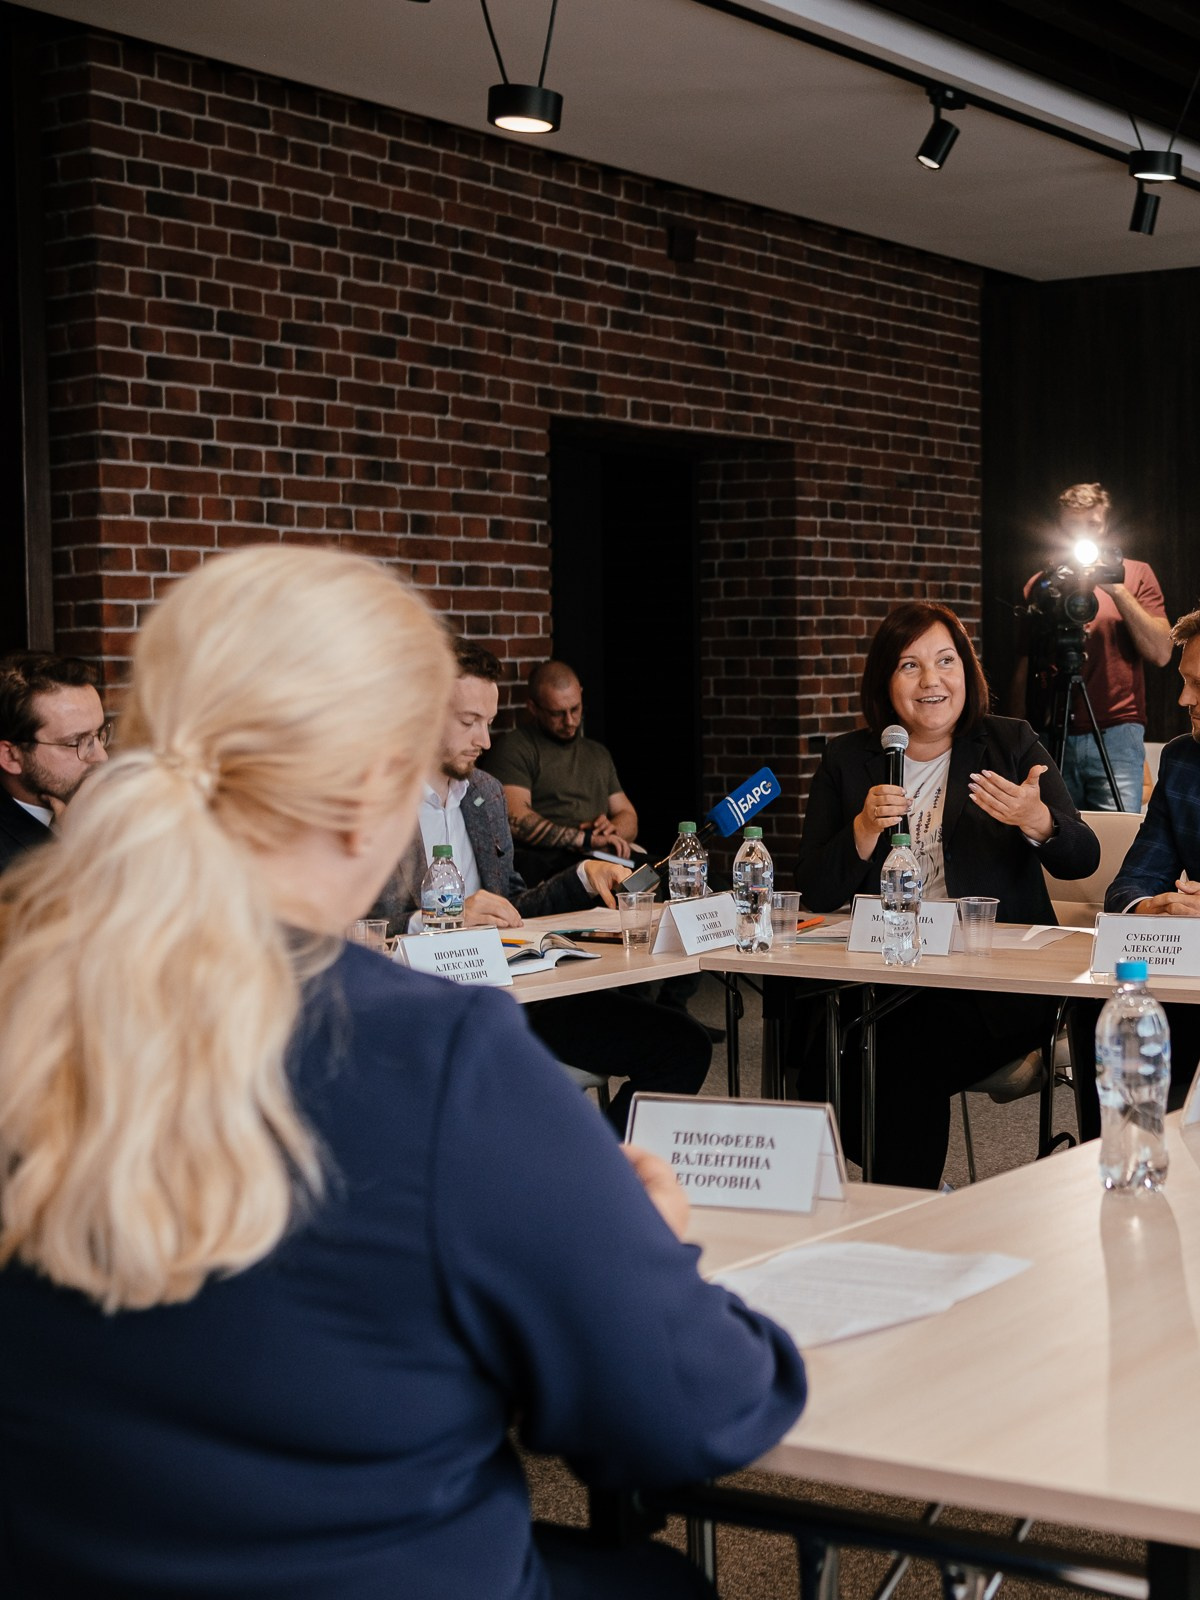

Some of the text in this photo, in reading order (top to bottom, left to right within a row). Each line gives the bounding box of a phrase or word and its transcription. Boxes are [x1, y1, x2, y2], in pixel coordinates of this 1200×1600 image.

[738, 780, 772, 814] БАРС
[695, 910, 719, 921] КОТЛЕР
[696, 929, 735, 944] ДМИТРИЕВИЧ
[1126, 933, 1181, 943] СУББОТИН
[433, 947, 480, 961] ШОРЫГИН
[1121, 944, 1183, 955] АЛЕКСАНДР
[435, 959, 485, 973] АЛЕКСАНДР
[672, 1131, 776, 1150] ТИМОФЕЕВА
[670, 1152, 771, 1170] ВАЛЕНТИНА
[675, 1172, 761, 1190] ЕГОРОВНА
